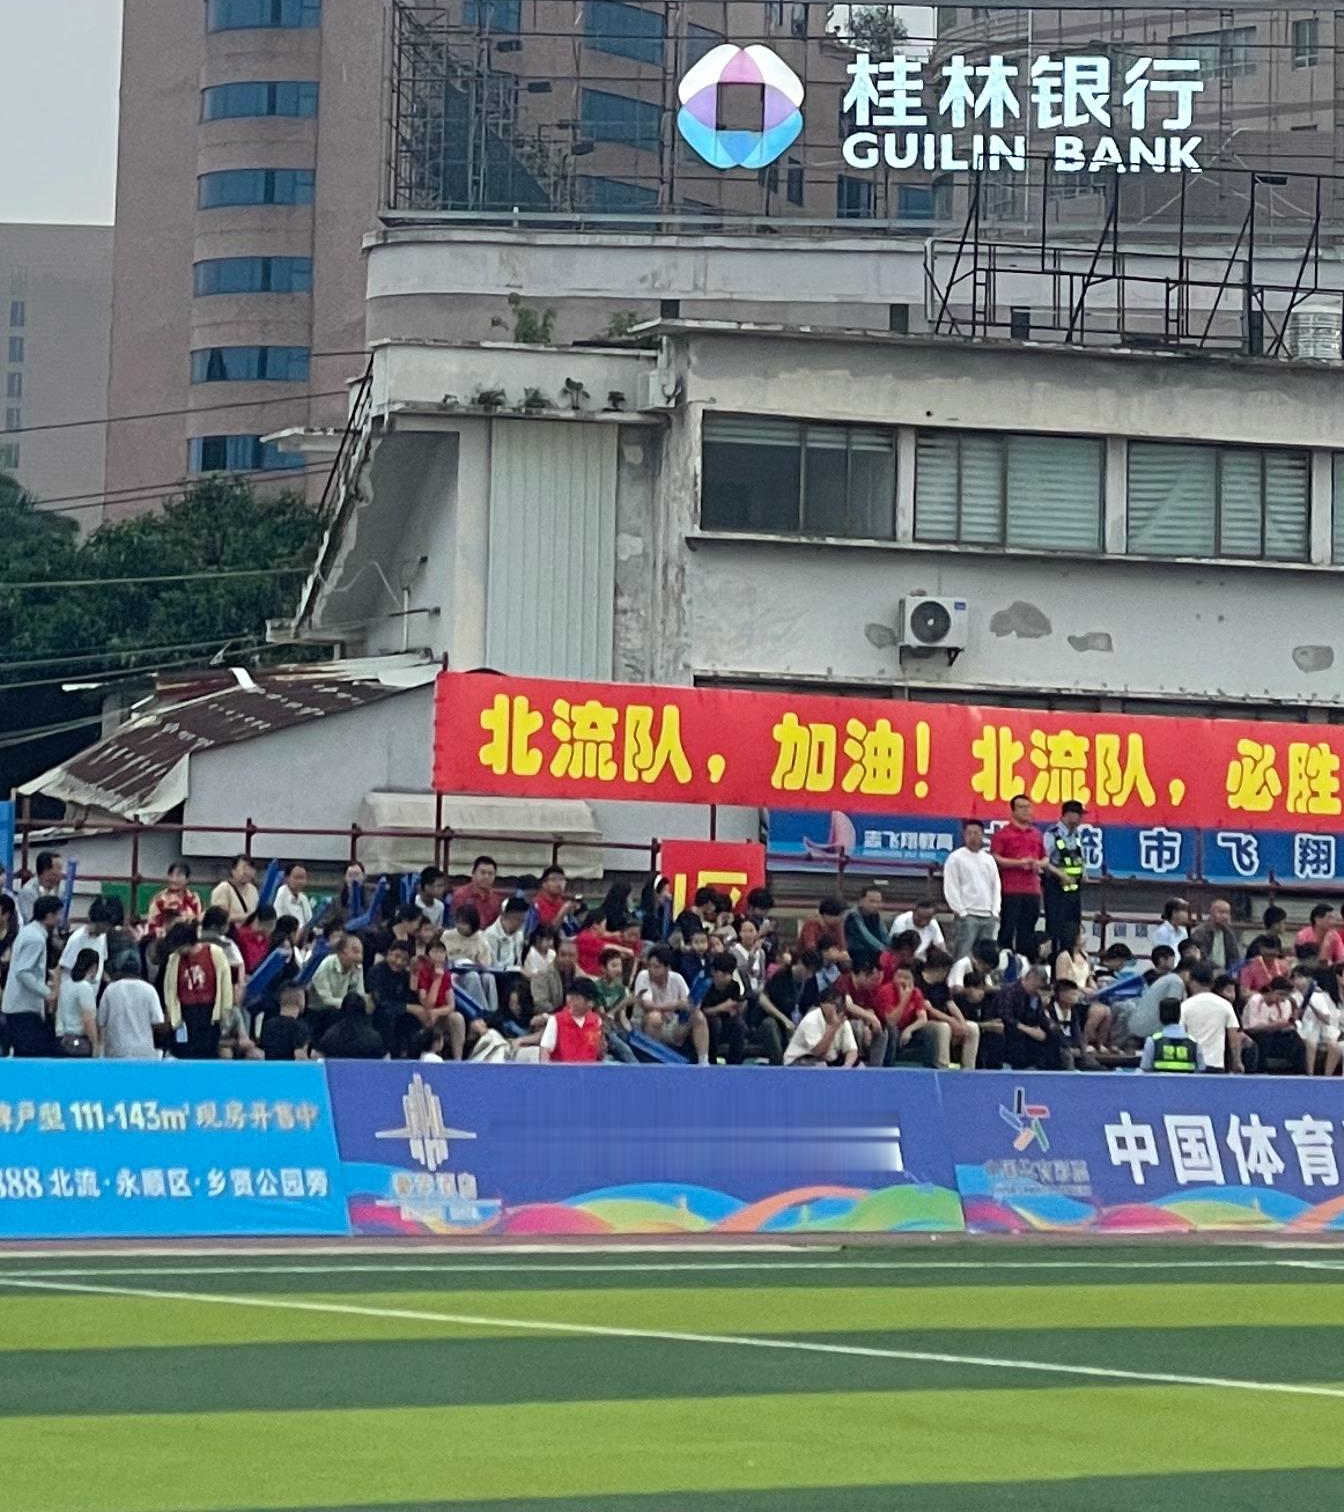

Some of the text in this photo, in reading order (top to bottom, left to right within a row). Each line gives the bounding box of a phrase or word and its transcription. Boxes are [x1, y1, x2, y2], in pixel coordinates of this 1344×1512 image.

[842, 54, 1204, 130] 桂林银行
[842, 132, 1204, 174] GUILIN BANK
